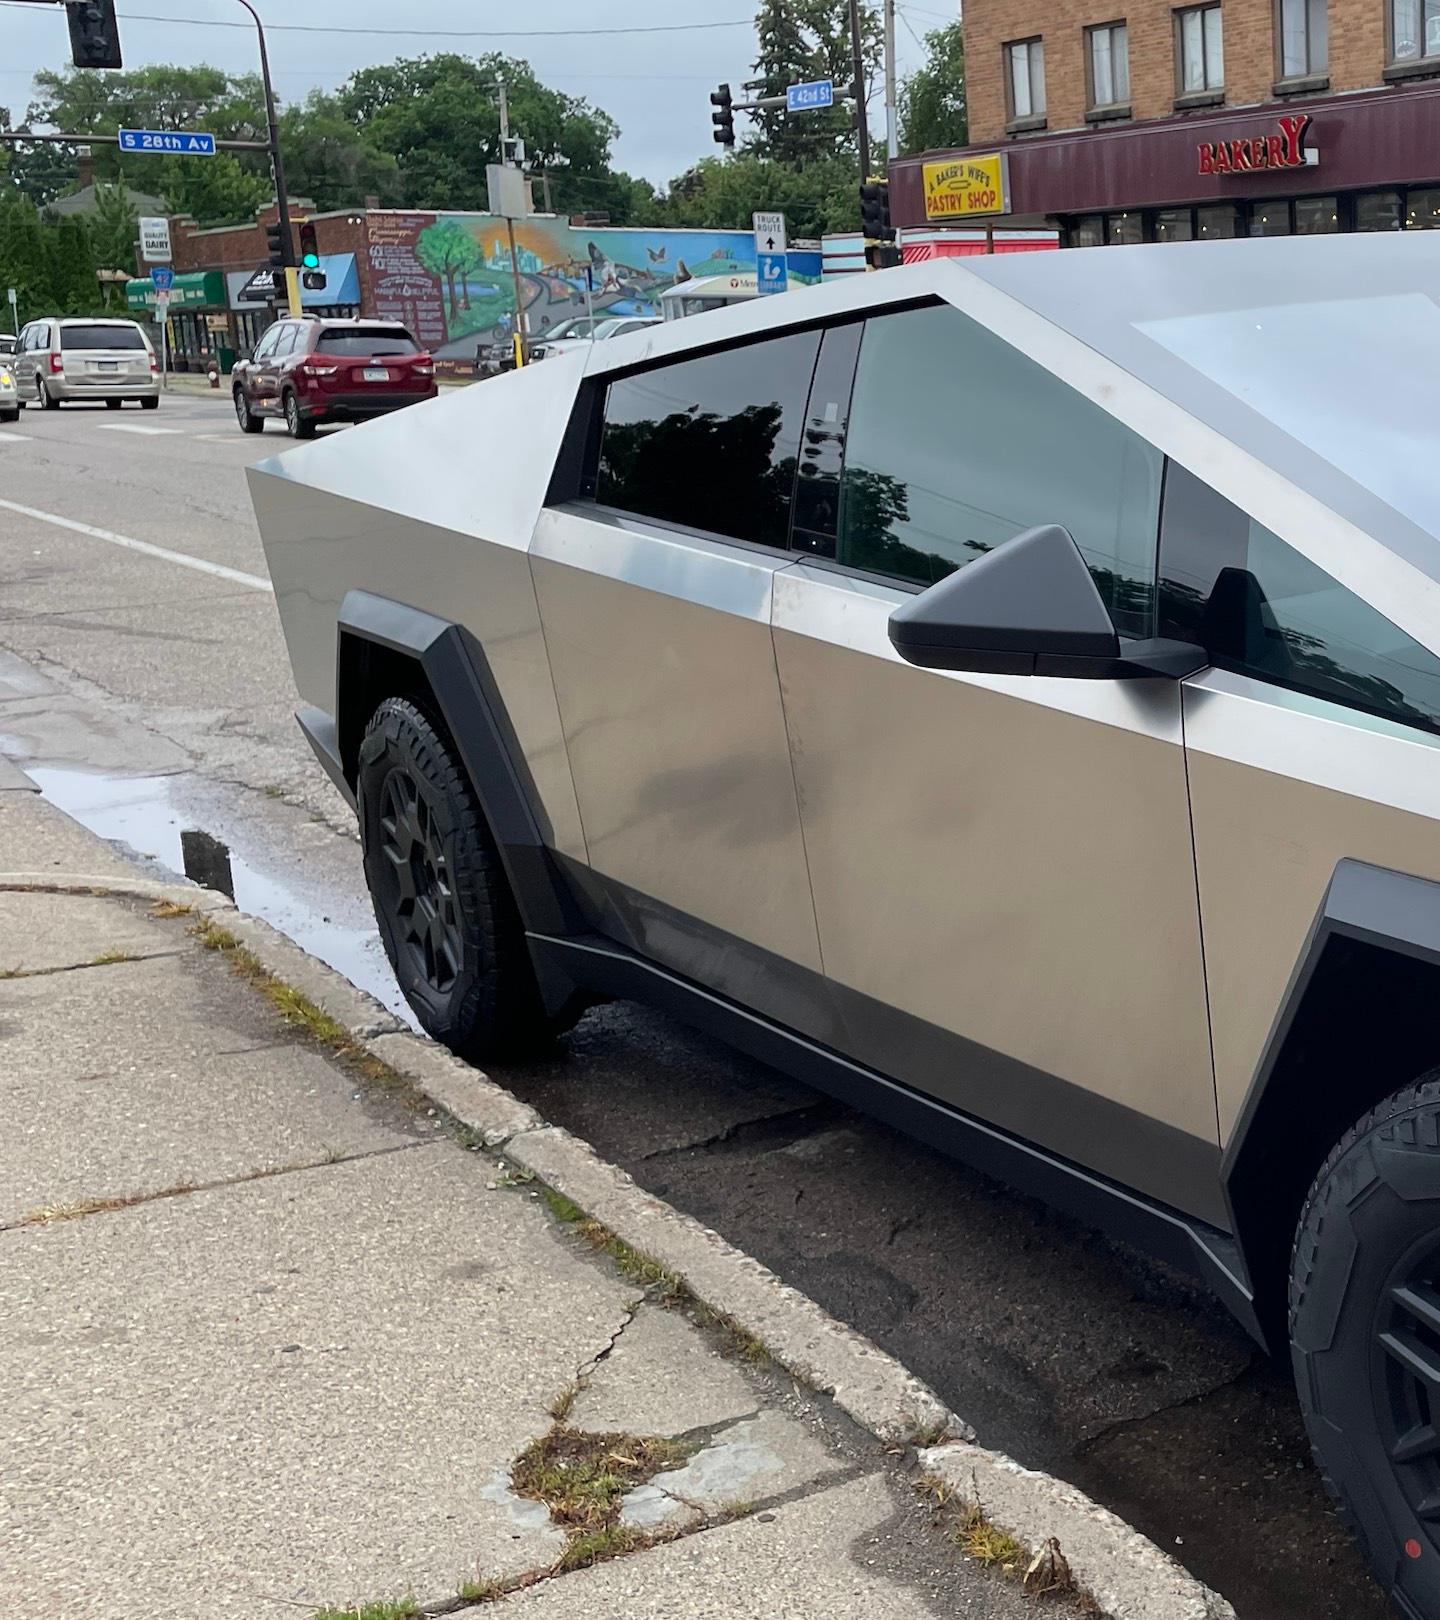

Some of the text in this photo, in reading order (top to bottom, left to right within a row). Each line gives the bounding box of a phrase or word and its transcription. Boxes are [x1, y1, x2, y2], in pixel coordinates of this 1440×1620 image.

[797, 86, 817, 103] 42nd
[820, 86, 830, 101] St
[125, 134, 209, 150] S 28th Av
[1197, 115, 1309, 175] BAKERY
[929, 165, 990, 194] A BAKER'S WIFE'S
[927, 190, 996, 213] PASTRY SHOP
[757, 215, 780, 223] TRUCK
[757, 223, 782, 232] ROUTE
[145, 240, 169, 249] DAIRY
